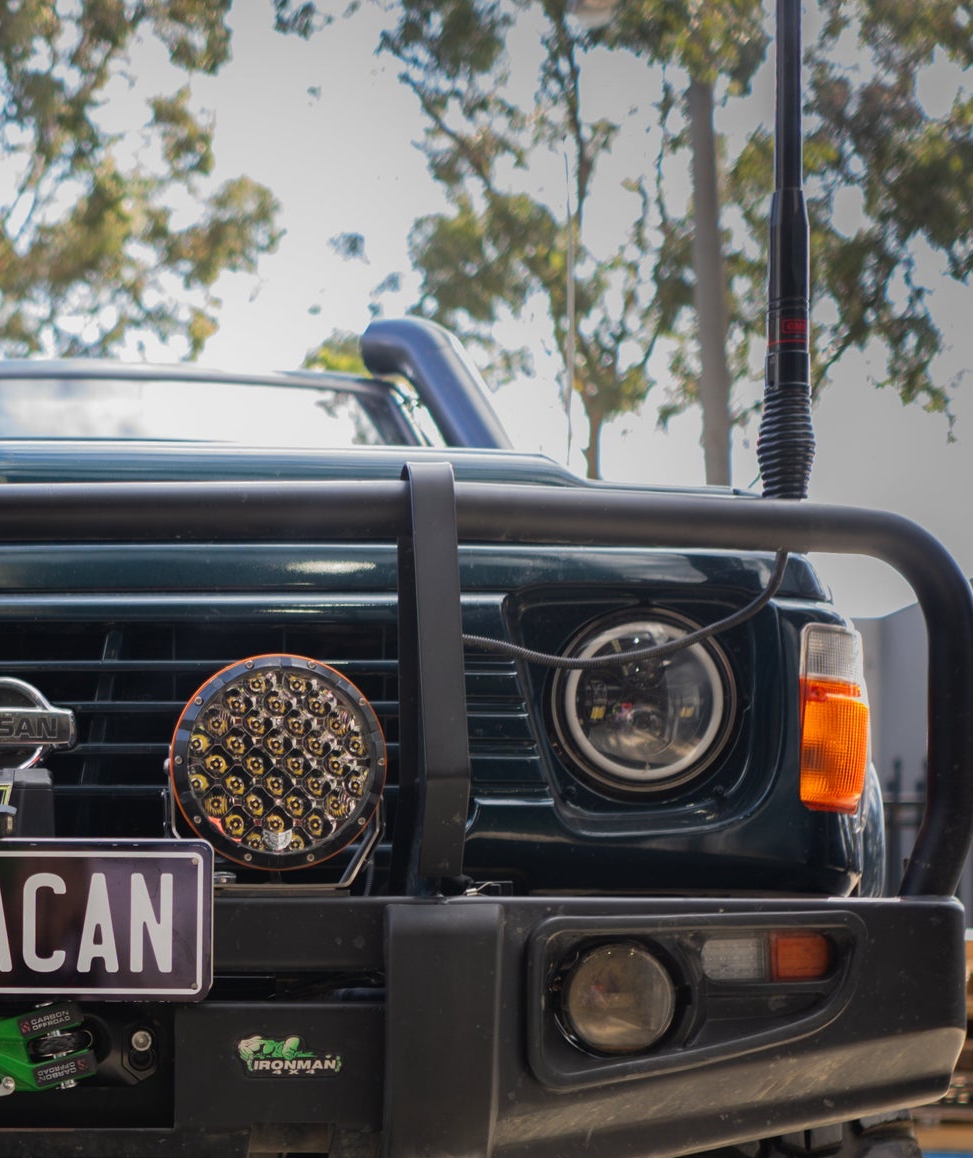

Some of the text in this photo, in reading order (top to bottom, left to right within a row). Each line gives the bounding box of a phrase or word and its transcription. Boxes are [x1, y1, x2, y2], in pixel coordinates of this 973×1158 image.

[31, 1010, 69, 1025] CARBON
[32, 1015, 71, 1030] OFFROAD
[253, 1059, 336, 1070] IRONMAN
